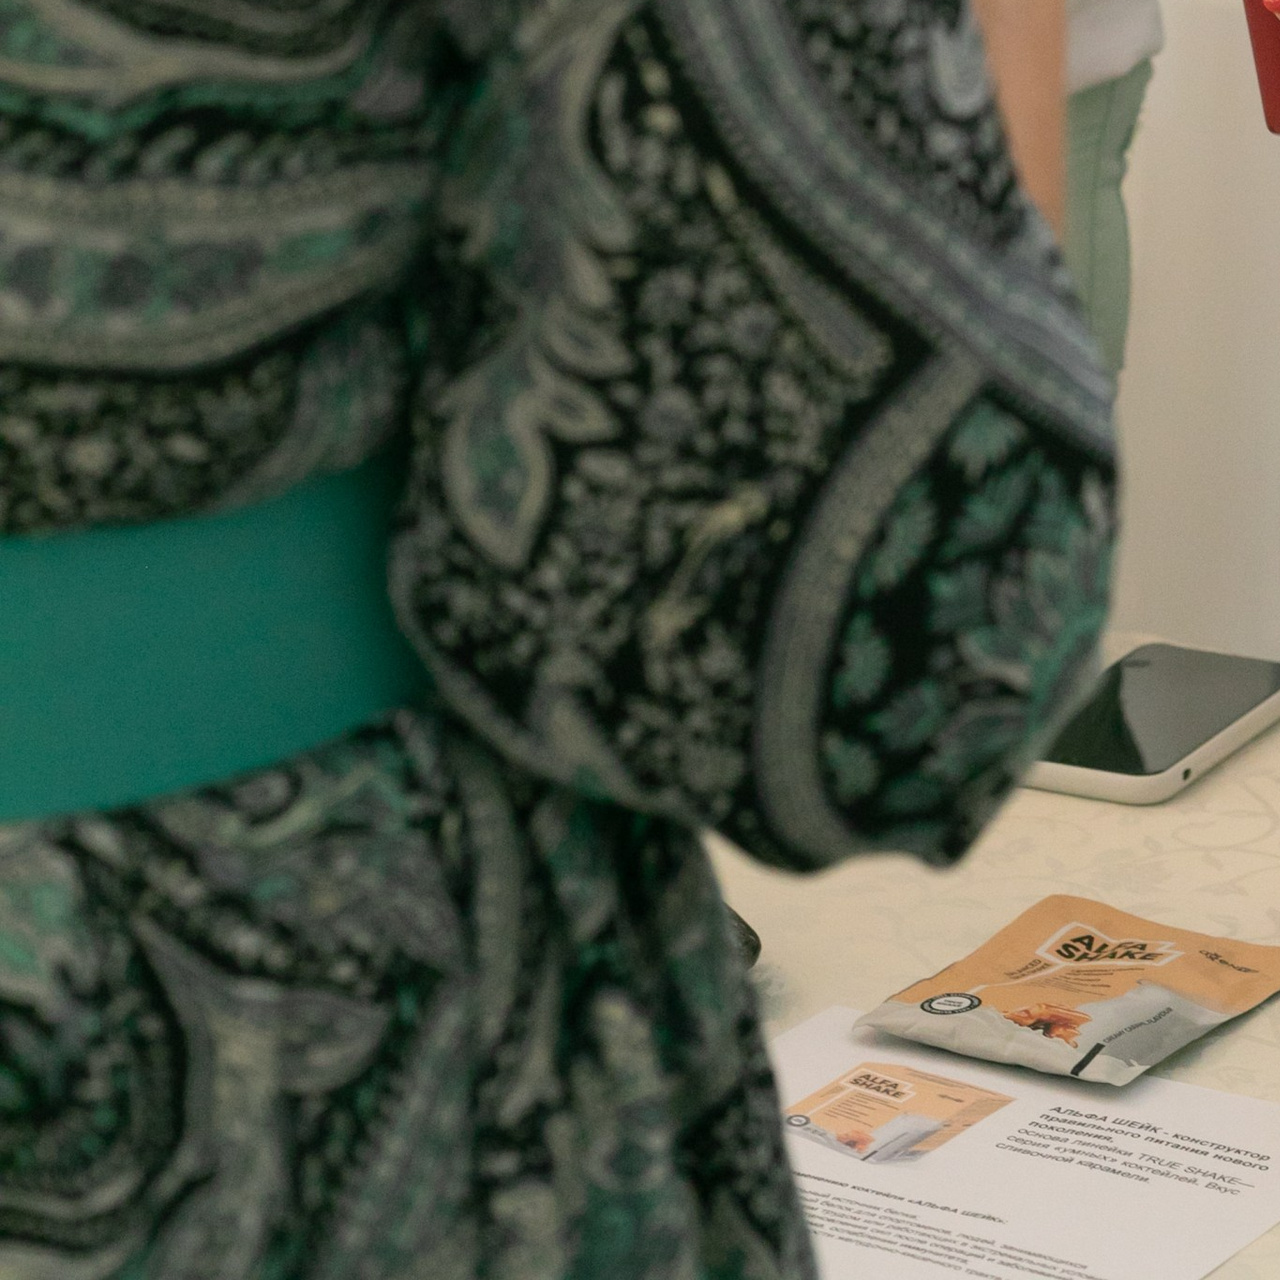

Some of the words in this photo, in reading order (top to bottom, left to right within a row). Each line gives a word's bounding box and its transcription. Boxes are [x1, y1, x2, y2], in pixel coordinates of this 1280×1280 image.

[1055, 943, 1164, 962] SHAKE
[850, 1077, 906, 1099] SHAKE
[859, 1072, 900, 1089] ALFA
[1017, 1128, 1070, 1145] основа
[1072, 1139, 1134, 1158] линейки
[1138, 1152, 1185, 1171] TRUE
[1028, 1120, 1114, 1143] поколения.
[1039, 1112, 1142, 1140] правильного
[1146, 1135, 1210, 1158] питания
[1212, 1152, 1270, 1172] нового
[1049, 1105, 1109, 1123] АЛЬФА
[1111, 1115, 1163, 1134] ШЕЙК
[1172, 1131, 1272, 1162] конструктор
[994, 1141, 1075, 1165] сливочной
[1076, 1157, 1151, 1185] карамели.
[1006, 1135, 1057, 1152] серия
[1120, 1158, 1200, 1186] коктейлей.
[1204, 1181, 1241, 1197] Вкус
